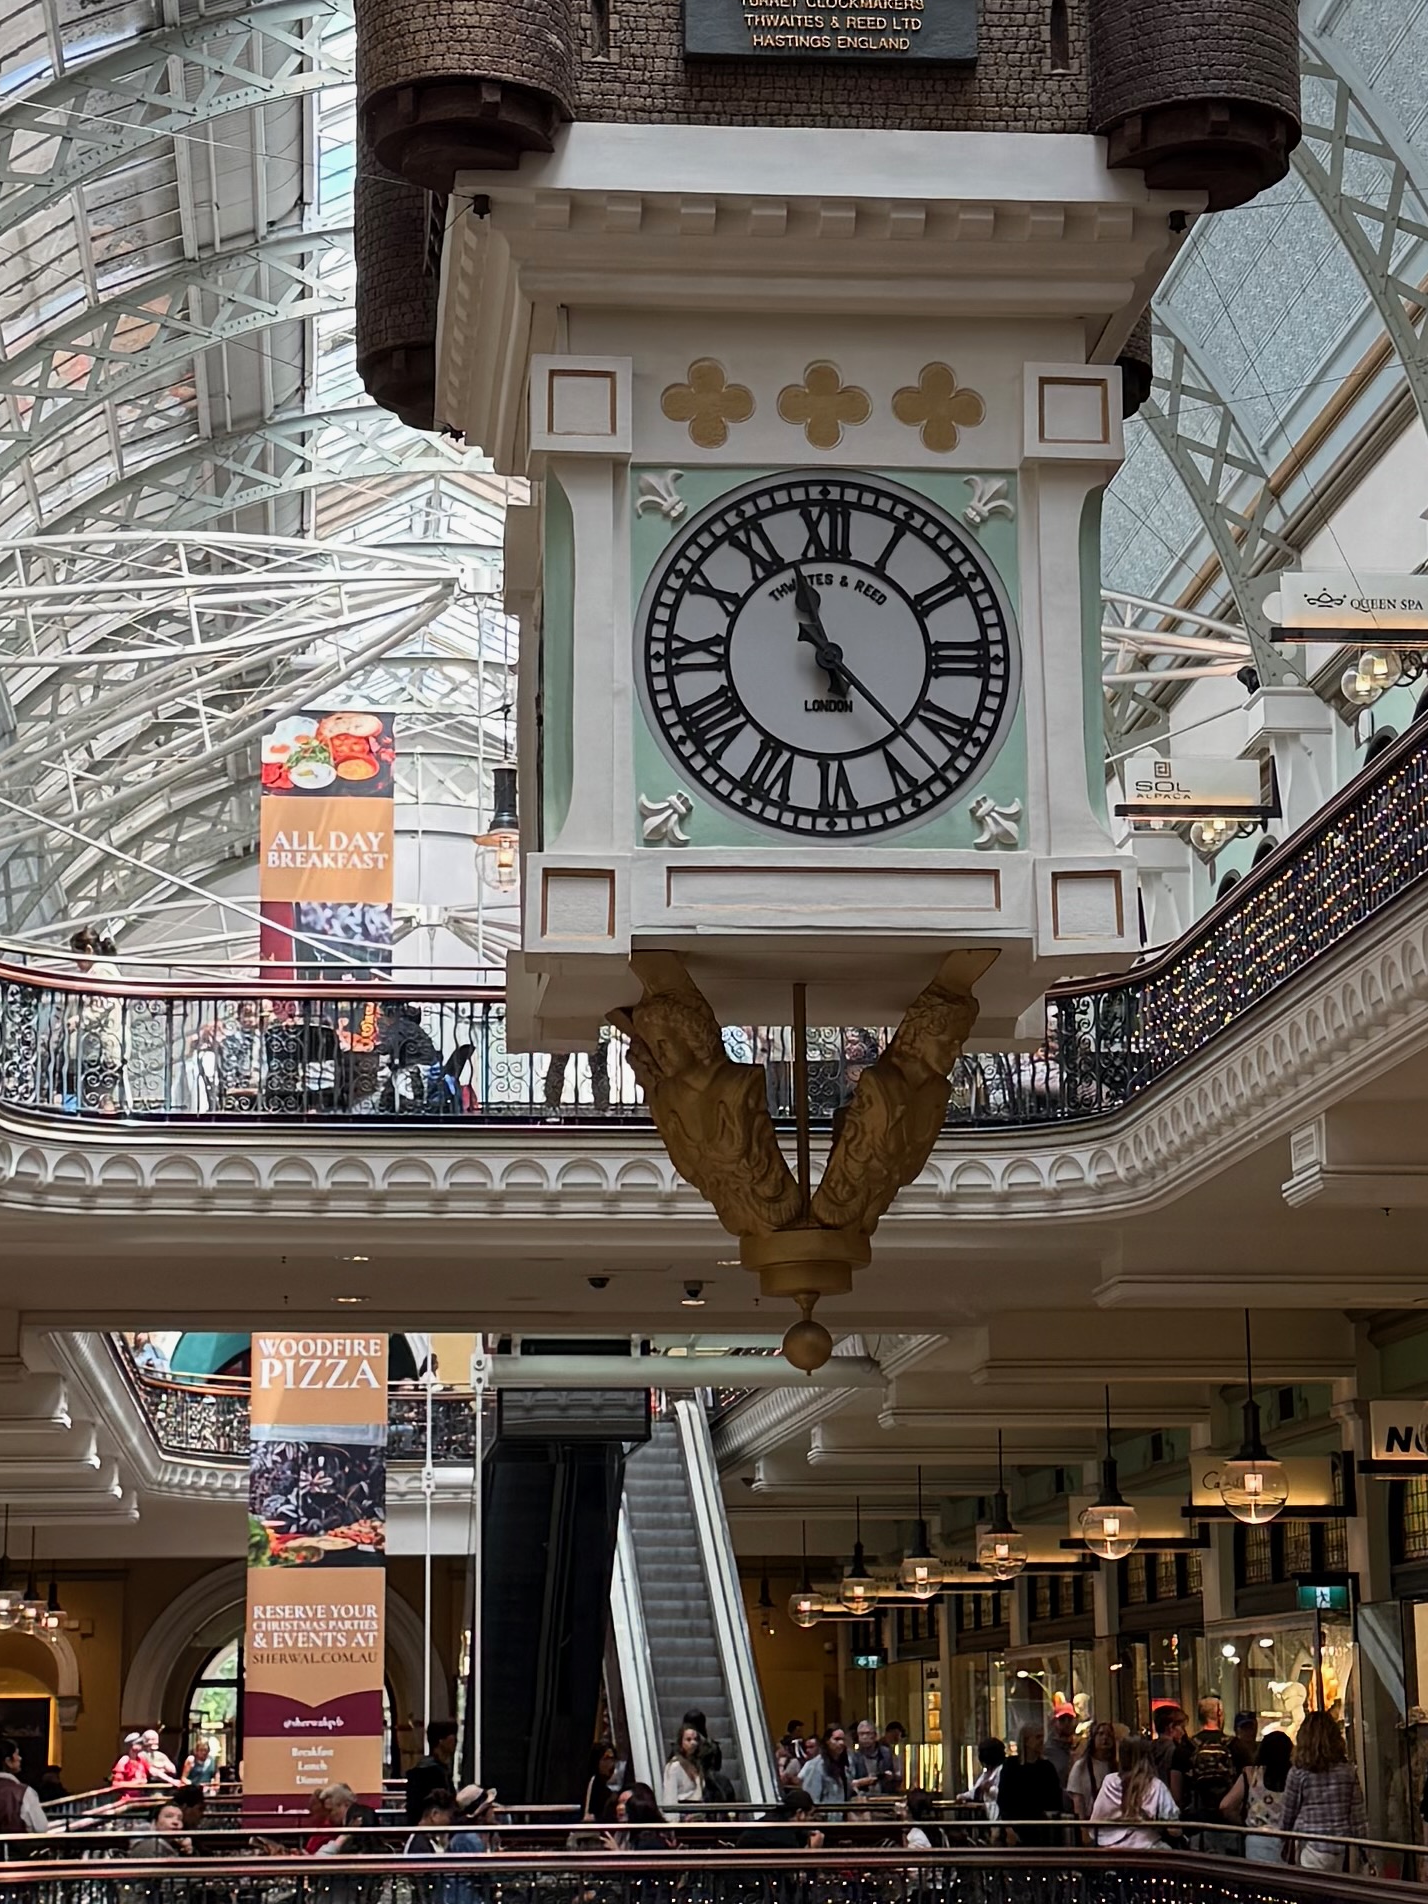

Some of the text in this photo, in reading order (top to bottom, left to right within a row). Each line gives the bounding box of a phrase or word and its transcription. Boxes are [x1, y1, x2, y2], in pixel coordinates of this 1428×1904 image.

[744, 13, 922, 31] THWAITES & REED LTD
[753, 33, 910, 50] HASTINGS ENGLAND
[799, 505, 852, 559] XII
[768, 573, 888, 606] THWTES & REED
[1350, 597, 1424, 614] QUEEN SPA
[803, 698, 854, 713] LONDON
[1134, 780, 1191, 793] SOL
[270, 831, 385, 853] ALL DAY
[267, 852, 389, 871] BREAKFAST
[258, 1338, 382, 1358] WOODFIRE
[258, 1358, 381, 1390] PIZZA
[253, 1604, 379, 1618] RESERVE YOUR
[252, 1619, 379, 1631] CHRISTMAS PARTIES
[252, 1631, 379, 1649] & EVENTS AT
